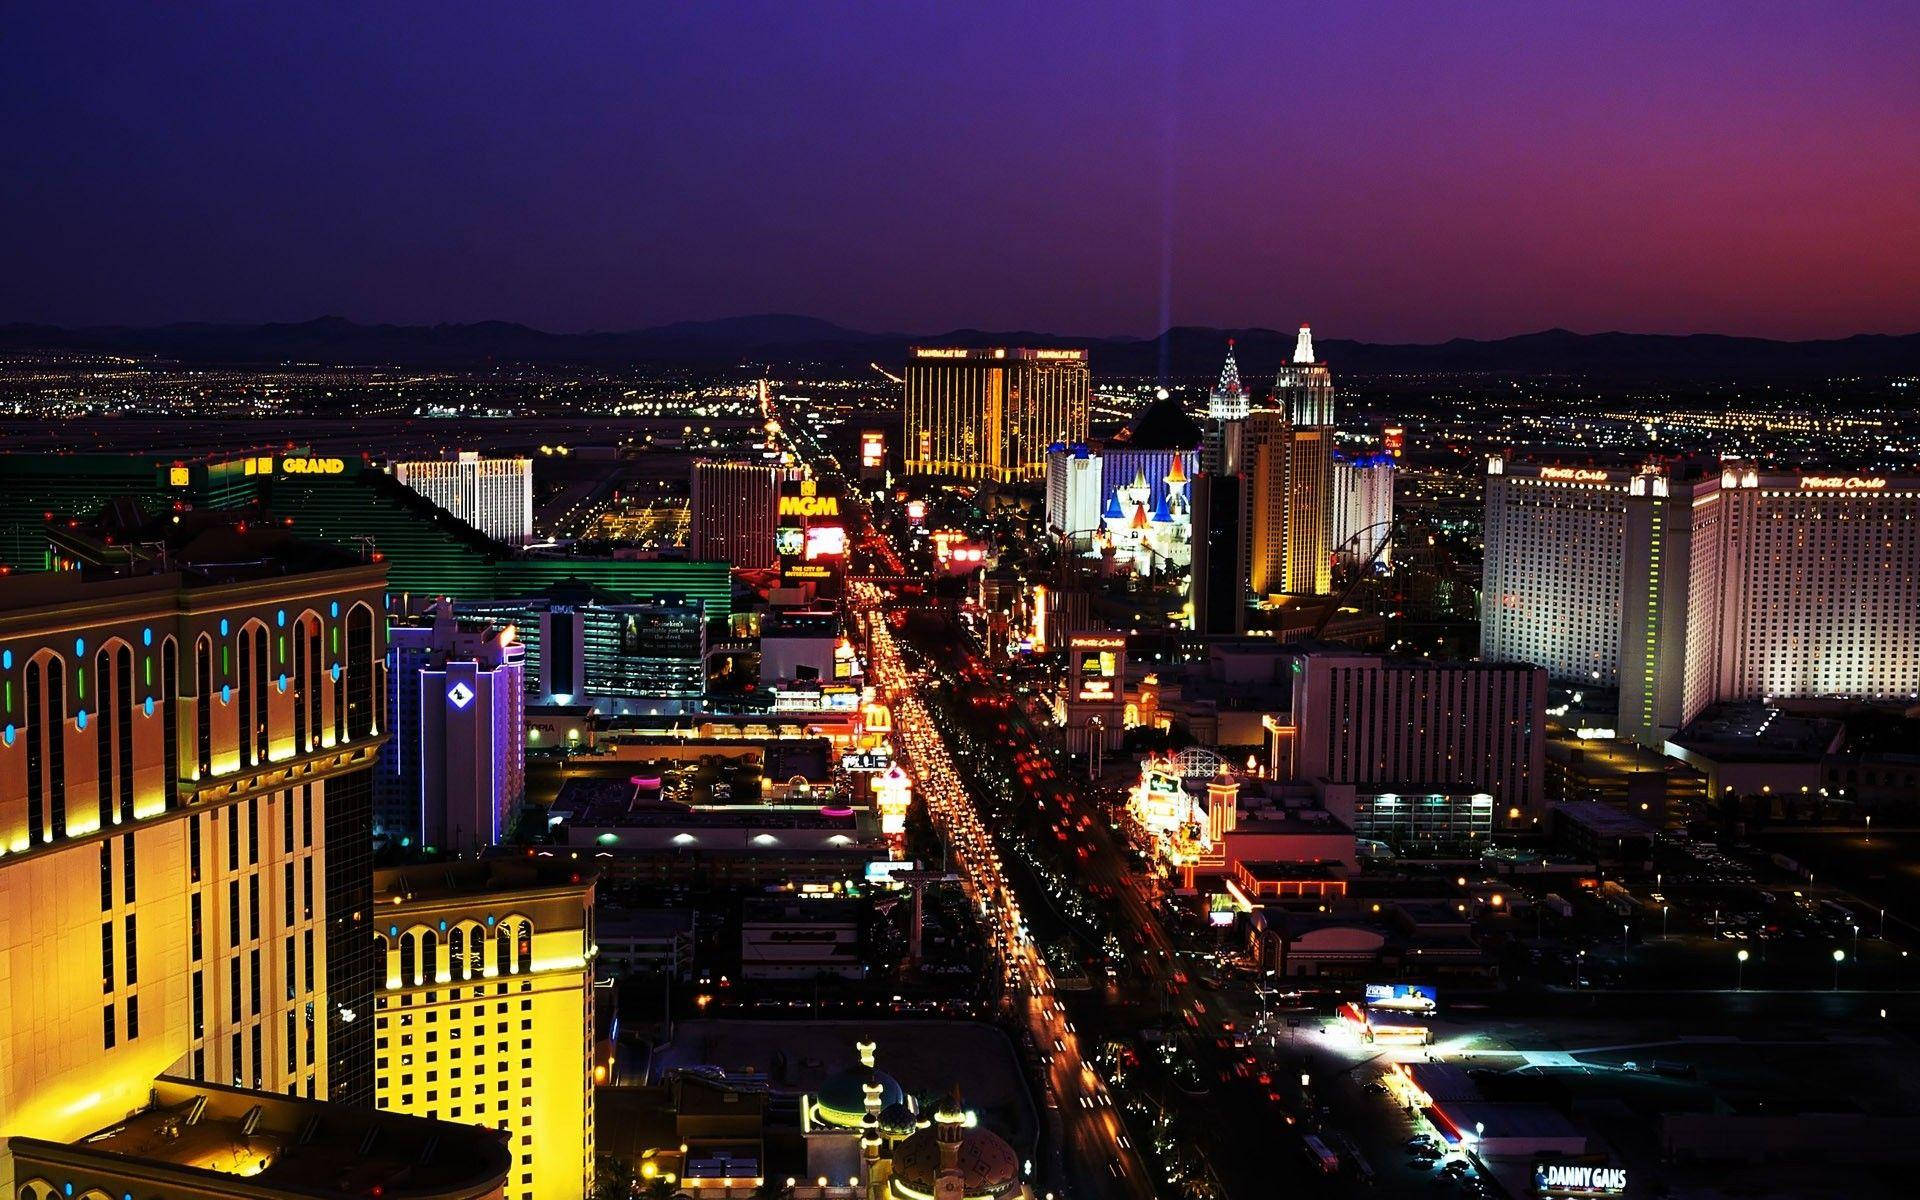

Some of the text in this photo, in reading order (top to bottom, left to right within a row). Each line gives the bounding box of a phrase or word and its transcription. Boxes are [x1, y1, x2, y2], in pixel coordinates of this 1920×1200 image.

[282, 458, 344, 474] GRAND
[1540, 467, 1608, 481] Monte Carlo
[1800, 476, 1886, 488] Monte Carlo
[779, 497, 838, 516] MGM
[1071, 638, 1125, 647] Monte Carlo
[1548, 1165, 1627, 1188] DANNY GANS
